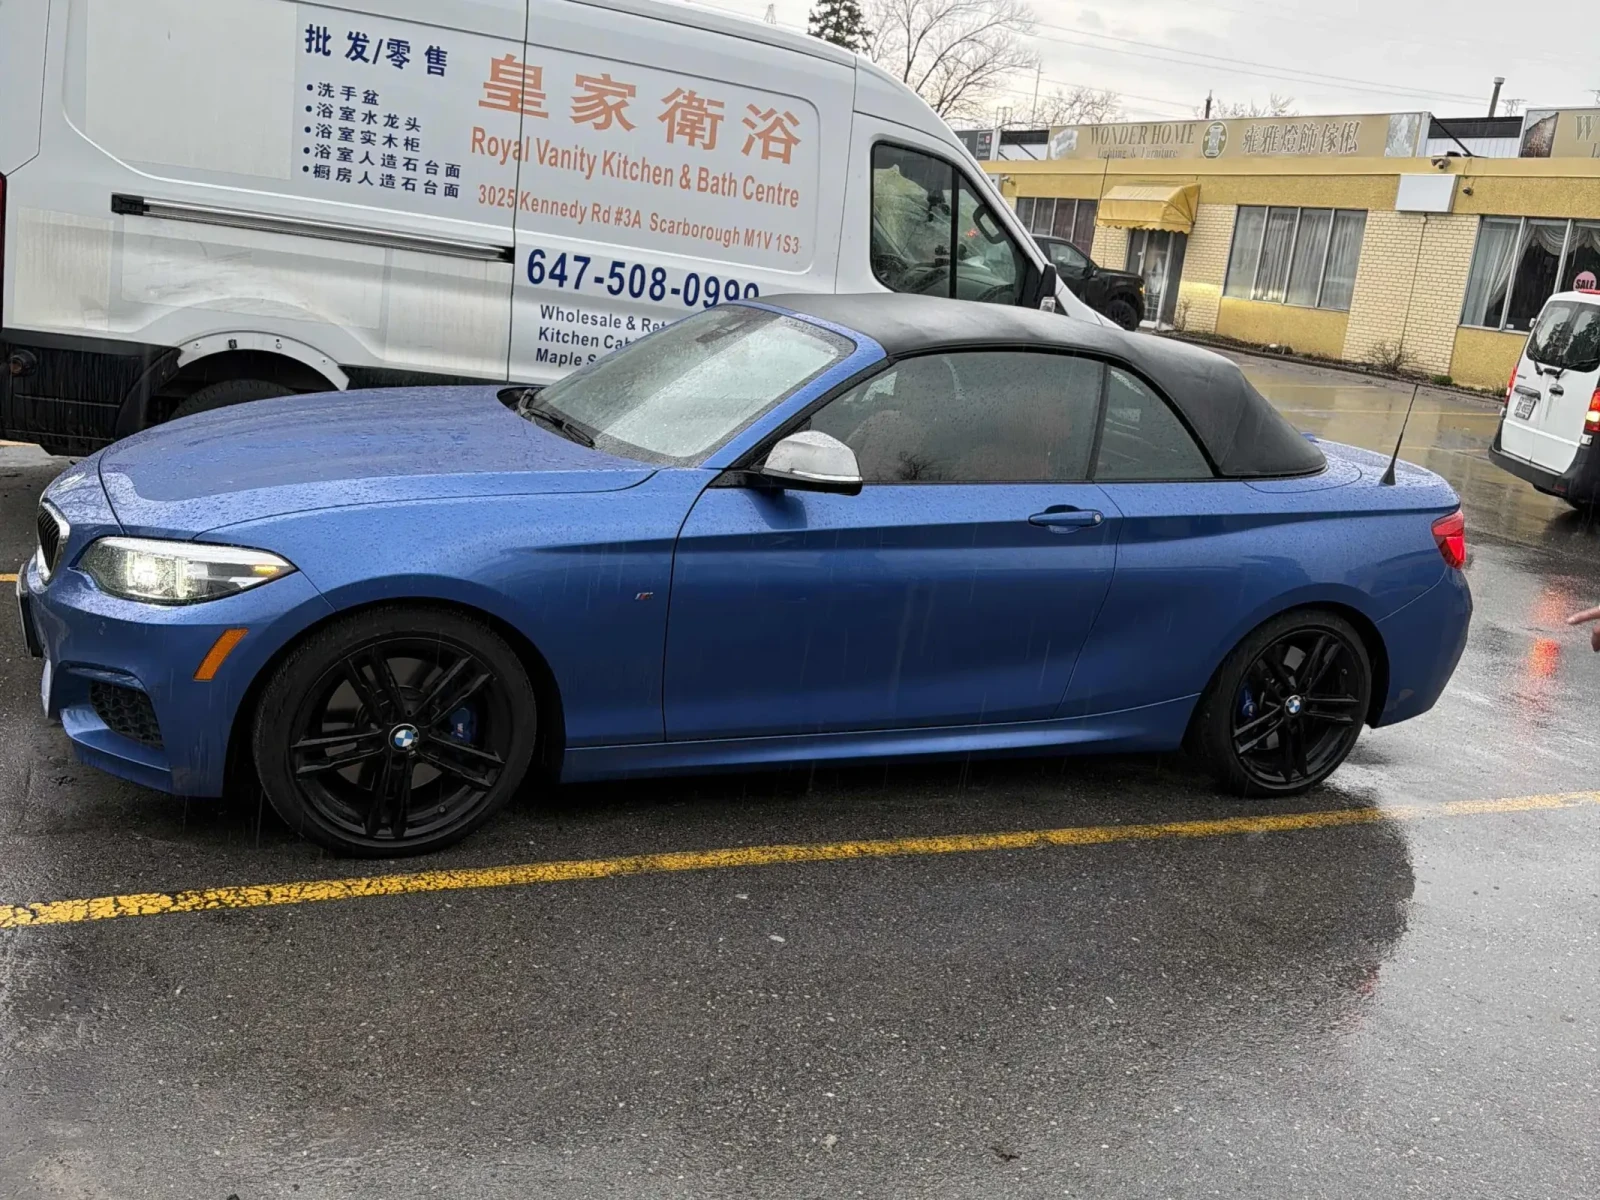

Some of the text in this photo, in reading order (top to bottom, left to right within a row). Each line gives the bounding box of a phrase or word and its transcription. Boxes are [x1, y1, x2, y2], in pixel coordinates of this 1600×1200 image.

[304, 24, 448, 77] 批发/零售
[317, 81, 380, 106] 洗手盆
[316, 102, 422, 133] 浴室水龙头
[478, 53, 802, 165] 皇家衛浴
[315, 122, 421, 152] 浴室实木柜
[1090, 123, 1196, 146] WONDER HOME
[314, 143, 461, 179] 浴室人造石台面
[471, 126, 800, 208] Royal Vanity Kitchen & Bath Centre
[478, 184, 800, 254] 3025 Kennedy Rd #3A Scarborough M1V 1S3
[1575, 278, 1595, 290] SALE
[540, 304, 622, 330] Wholesale
[626, 315, 636, 331] &
[538, 326, 599, 348] Kitchen
[535, 347, 583, 367] Maple
